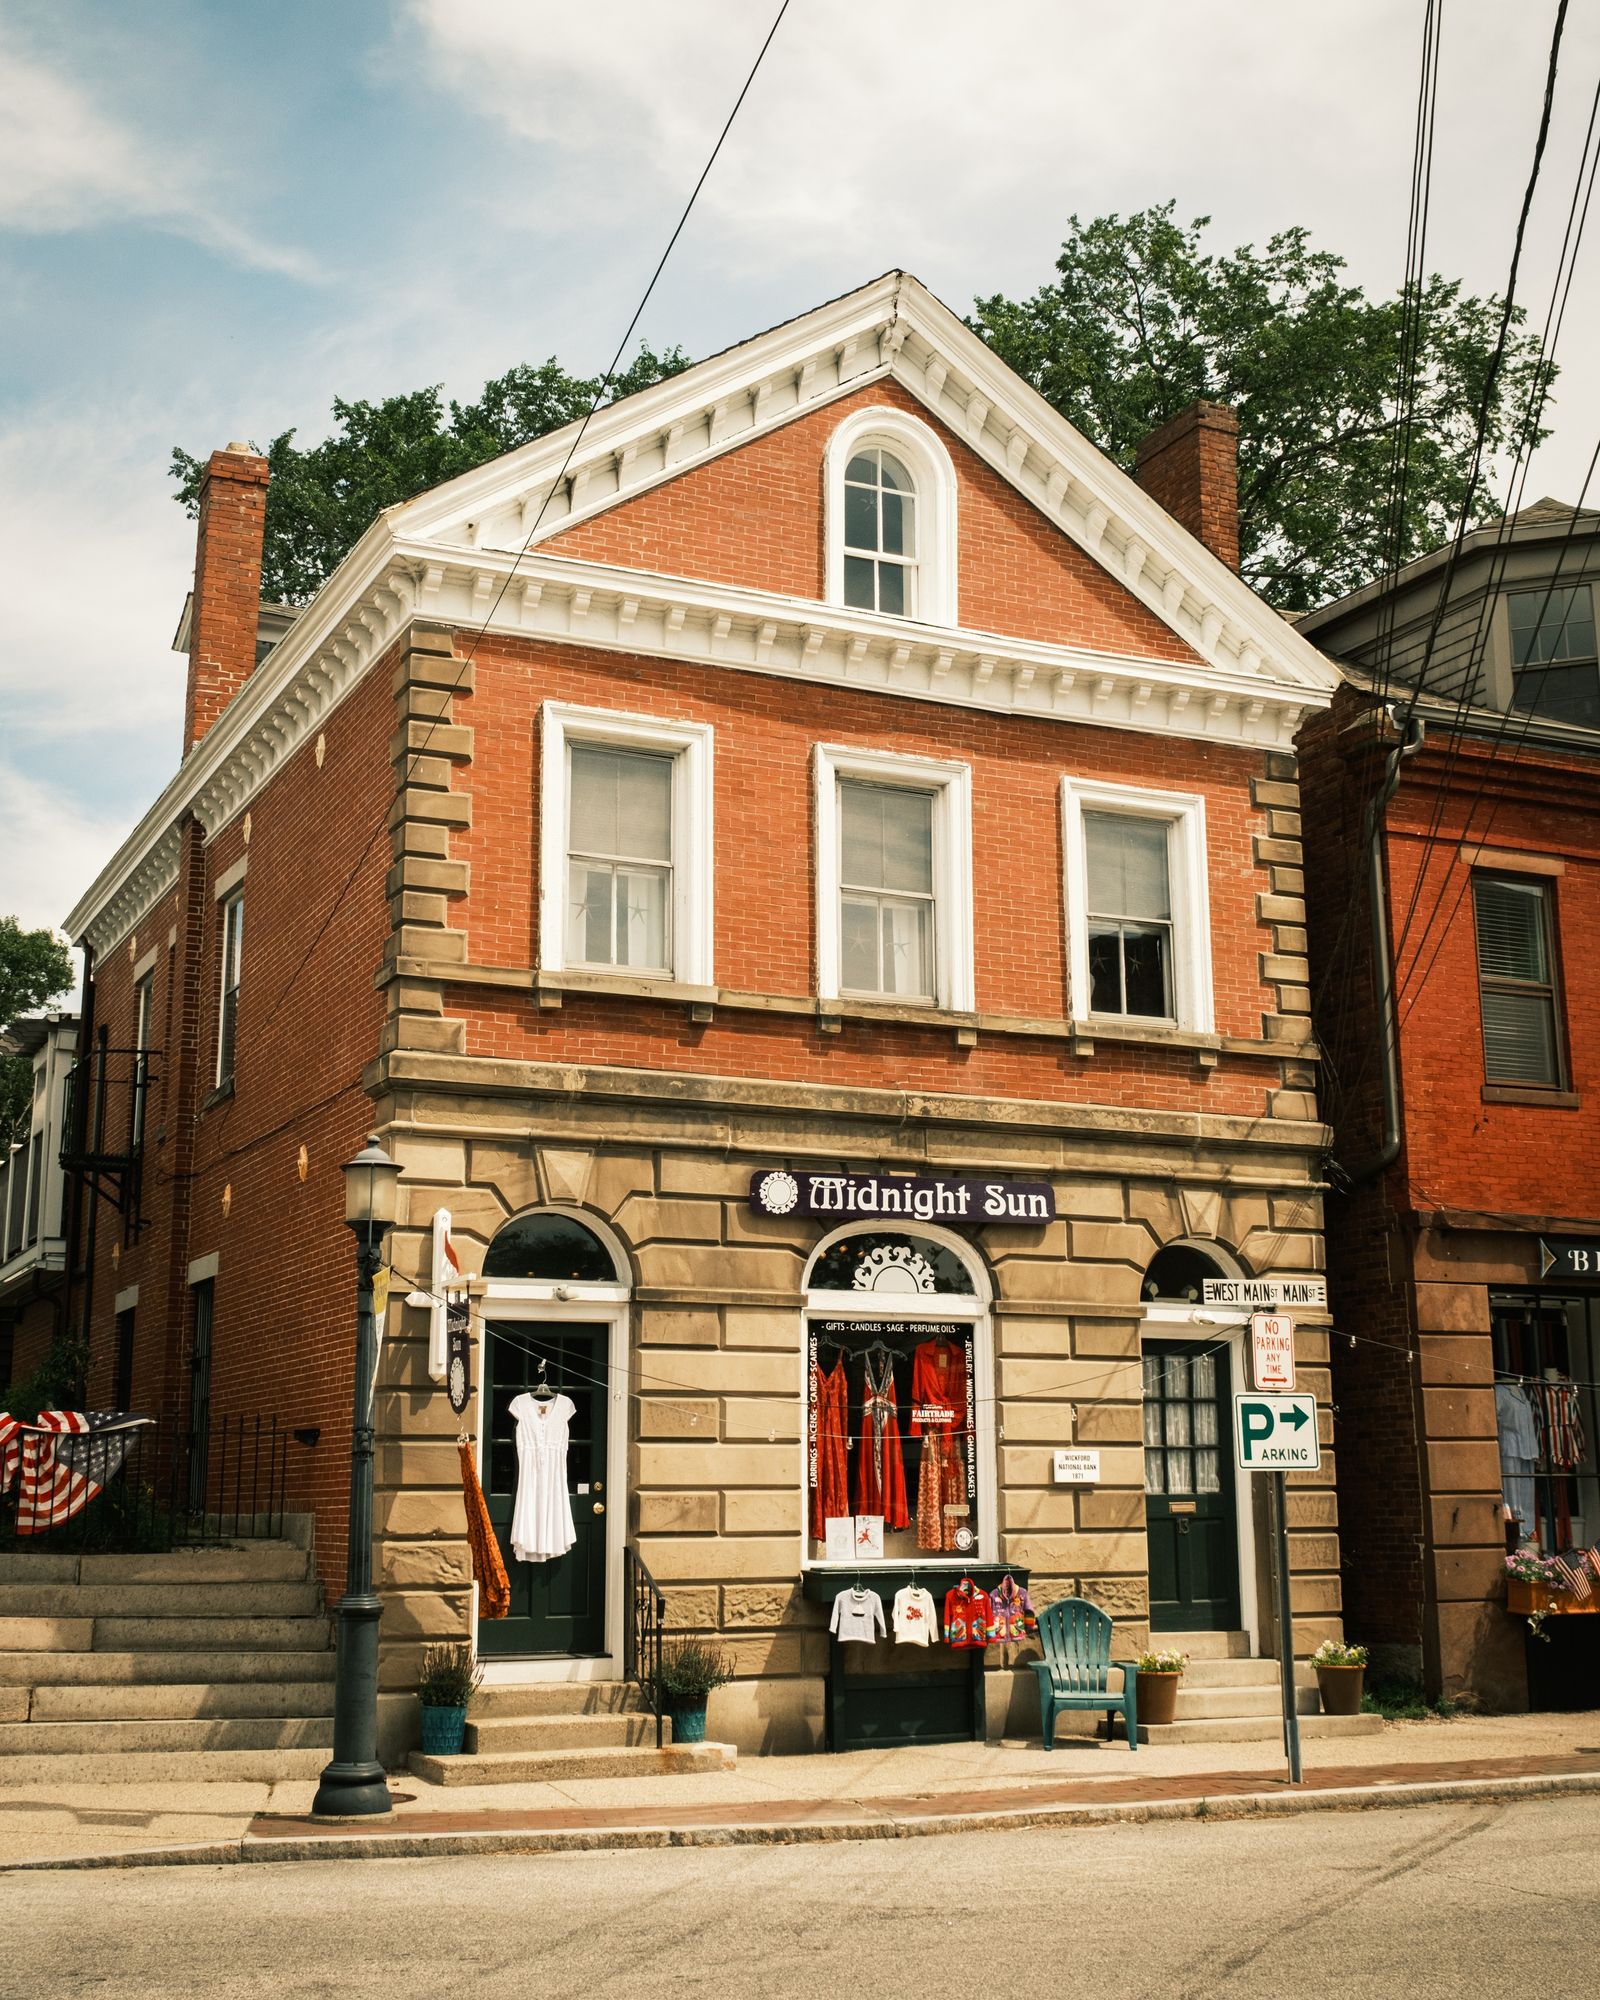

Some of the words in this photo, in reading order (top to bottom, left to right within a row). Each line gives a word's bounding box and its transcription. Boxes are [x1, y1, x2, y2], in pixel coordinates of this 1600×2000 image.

[809, 1177, 970, 1220] Midnight
[984, 1185, 1050, 1218] Sun
[1212, 1283, 1239, 1301] WEST
[1244, 1284, 1270, 1302] MAIN
[1270, 1289, 1278, 1298] ST
[1283, 1284, 1309, 1302] MAIN
[1308, 1289, 1316, 1298] ST
[825, 1322, 845, 1331] GIFTS
[850, 1322, 882, 1332] CANDLES
[886, 1323, 905, 1333] SAGE
[909, 1324, 940, 1333] PERFUME
[941, 1324, 956, 1333] OILS
[1264, 1320, 1279, 1335] NO
[1256, 1336, 1290, 1351] PARKING
[809, 1337, 818, 1372] SCARVES
[965, 1340, 973, 1373] JEWELRY
[1266, 1353, 1281, 1362] ANY
[1266, 1364, 1282, 1374] TIME
[912, 1410, 955, 1418] FAIRTRADE
[967, 1435, 975, 1463] GHANA
[810, 1448, 818, 1488] EARRINGS
[967, 1465, 976, 1498] BASKETS
